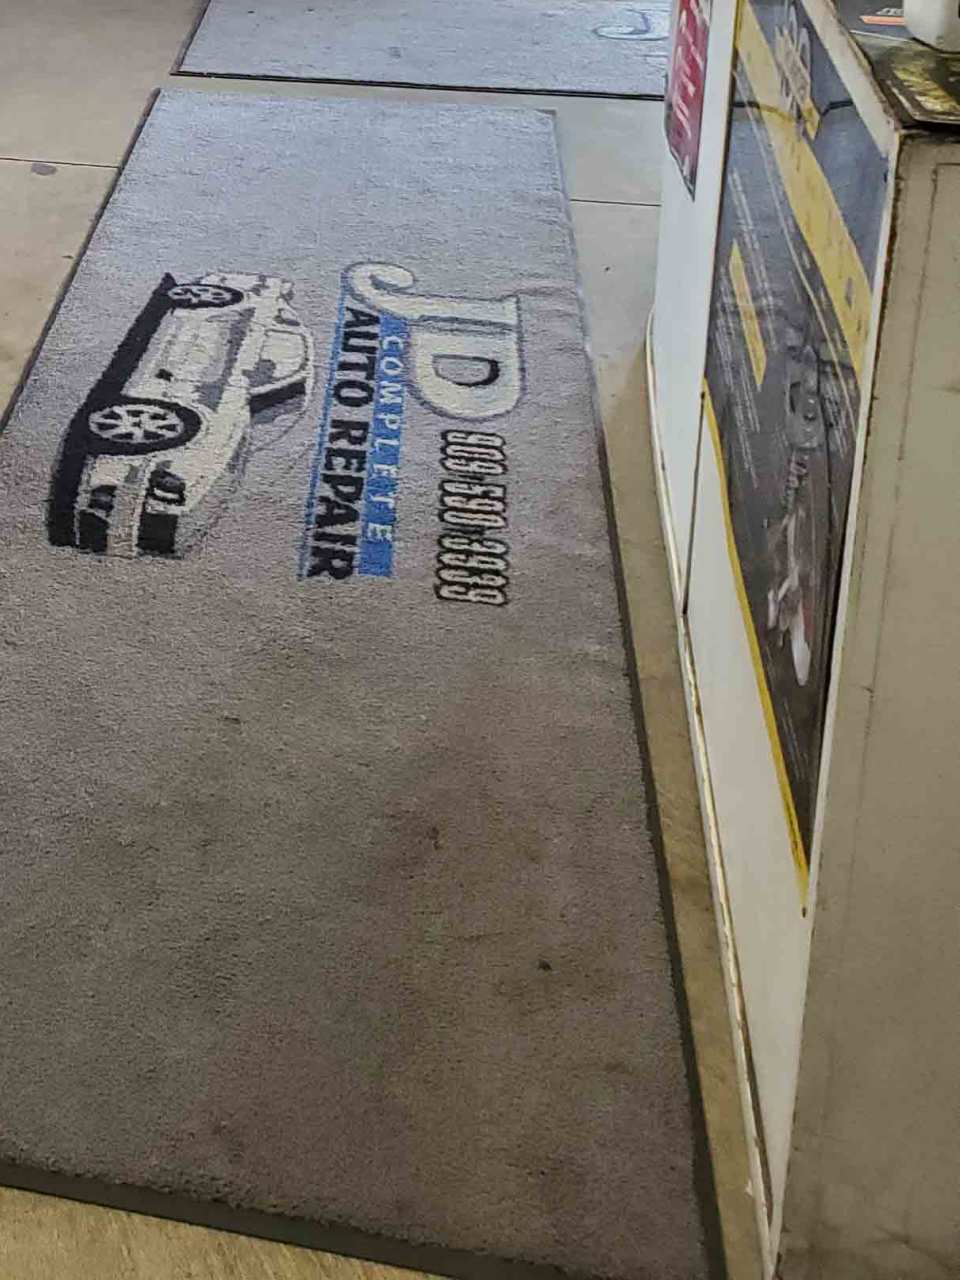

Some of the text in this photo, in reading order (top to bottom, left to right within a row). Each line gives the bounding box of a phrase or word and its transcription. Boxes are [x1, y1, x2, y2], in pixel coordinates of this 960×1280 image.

[306, 306, 381, 580] AUTO REPAIR
[343, 261, 522, 421] JD
[368, 334, 405, 543] COMPLETE
